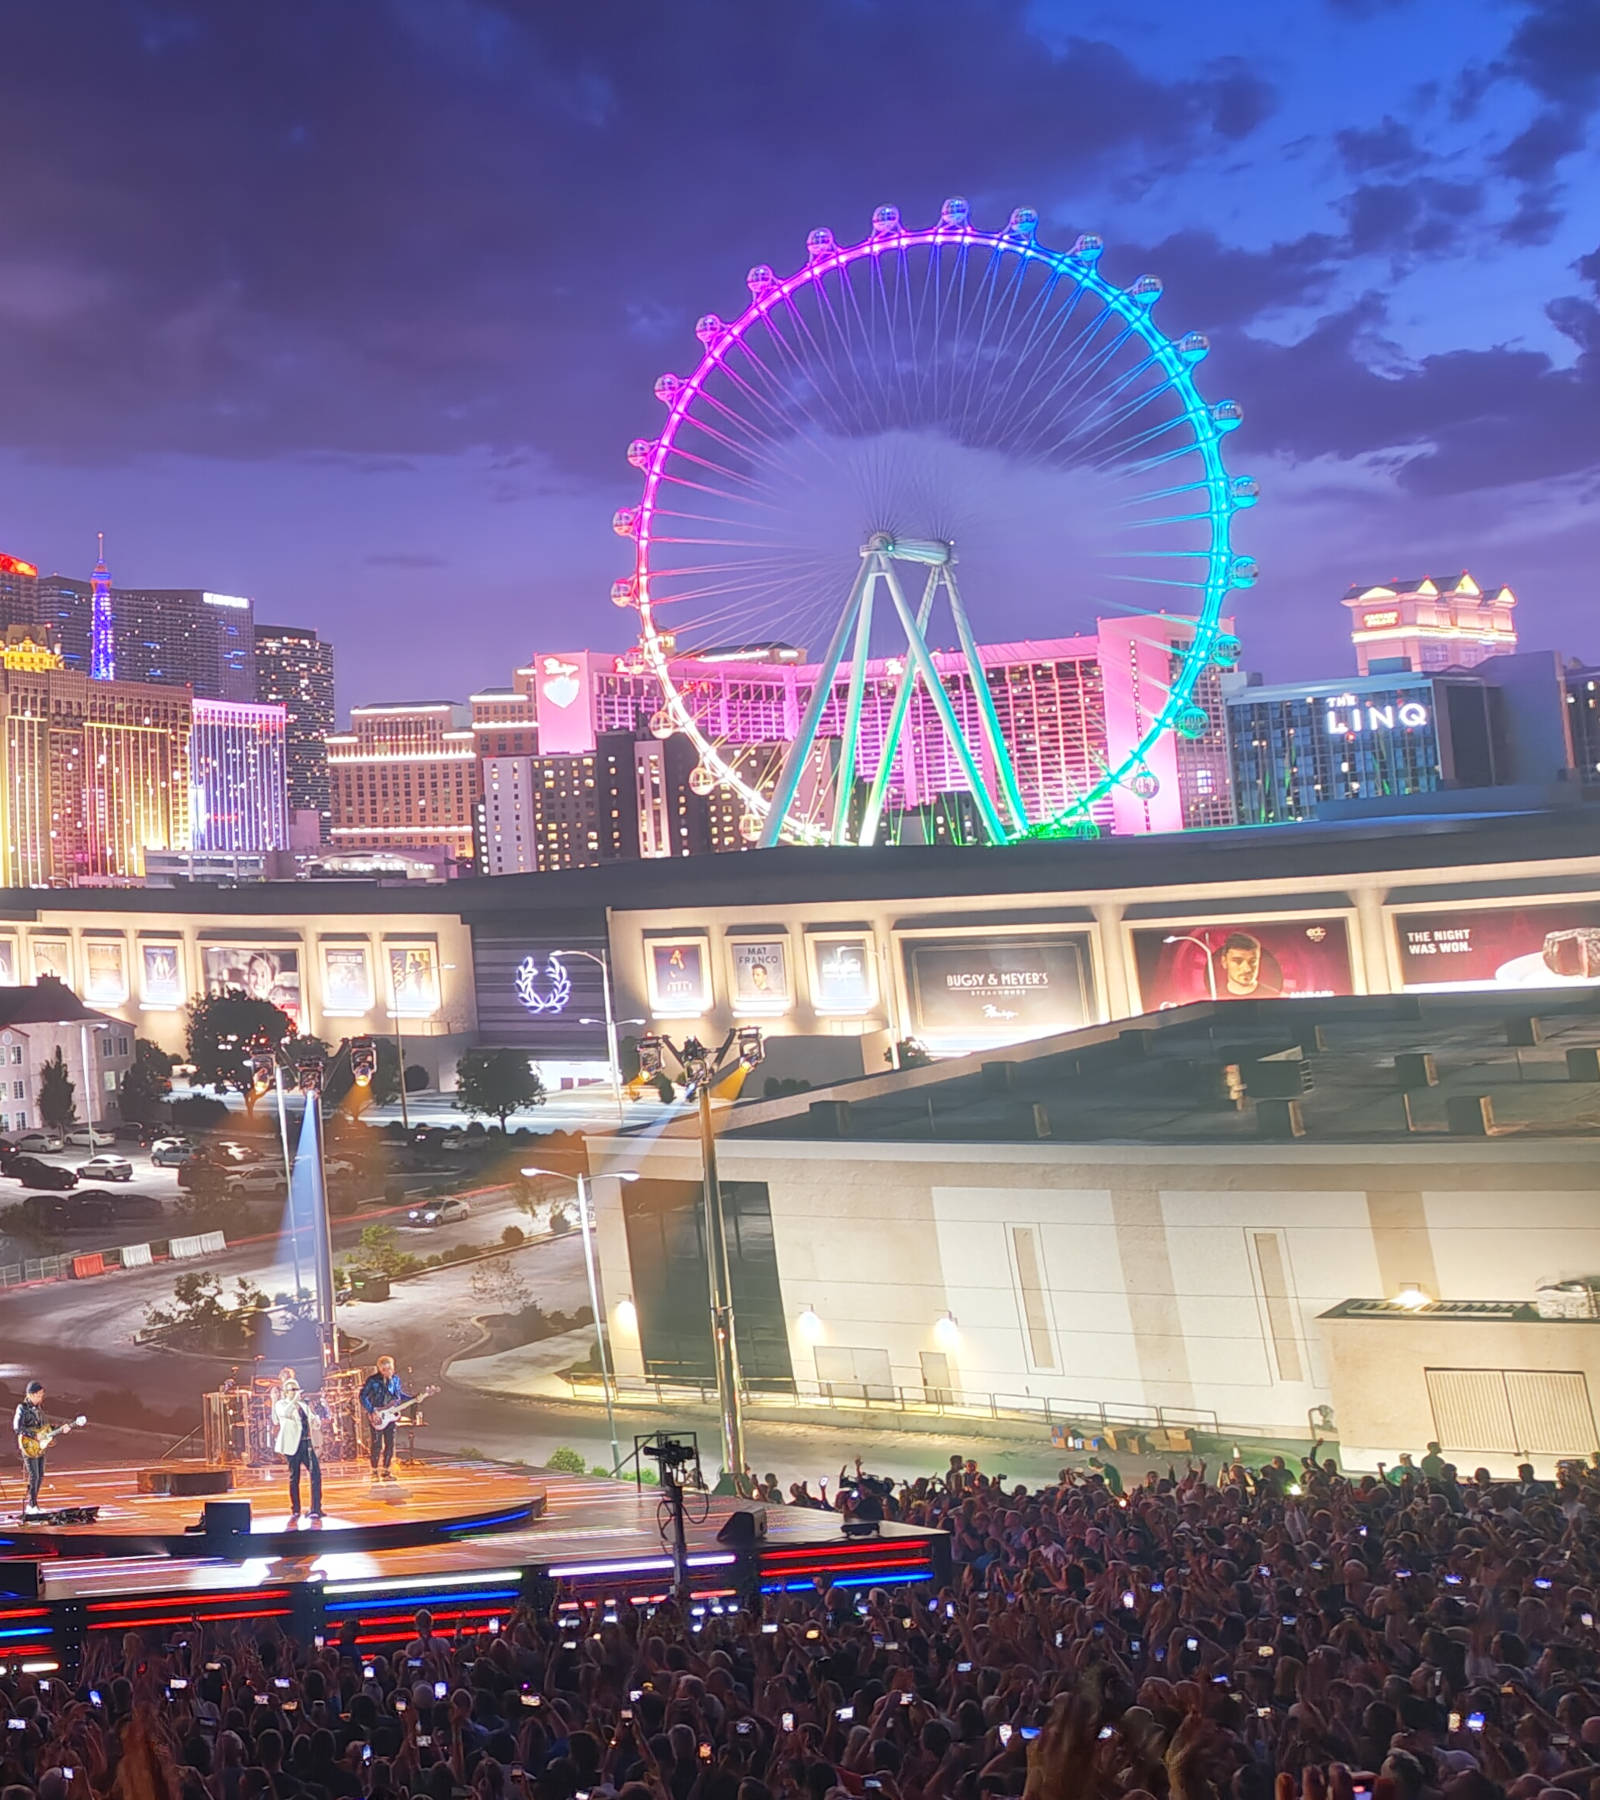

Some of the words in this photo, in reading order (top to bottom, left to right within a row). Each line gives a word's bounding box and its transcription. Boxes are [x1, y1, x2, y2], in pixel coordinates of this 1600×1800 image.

[1326, 694, 1357, 707] THE
[1327, 703, 1427, 734] LINQ
[1406, 931, 1432, 943] THE
[1433, 928, 1471, 941] NIGHT
[747, 946, 767, 955] MAT
[1408, 943, 1437, 955] WAS
[1439, 941, 1473, 953] WON.
[738, 955, 778, 964] FRANCO
[946, 974, 985, 987] BUGSY
[987, 973, 998, 986] &
[1000, 972, 1049, 986] MEYER'S
